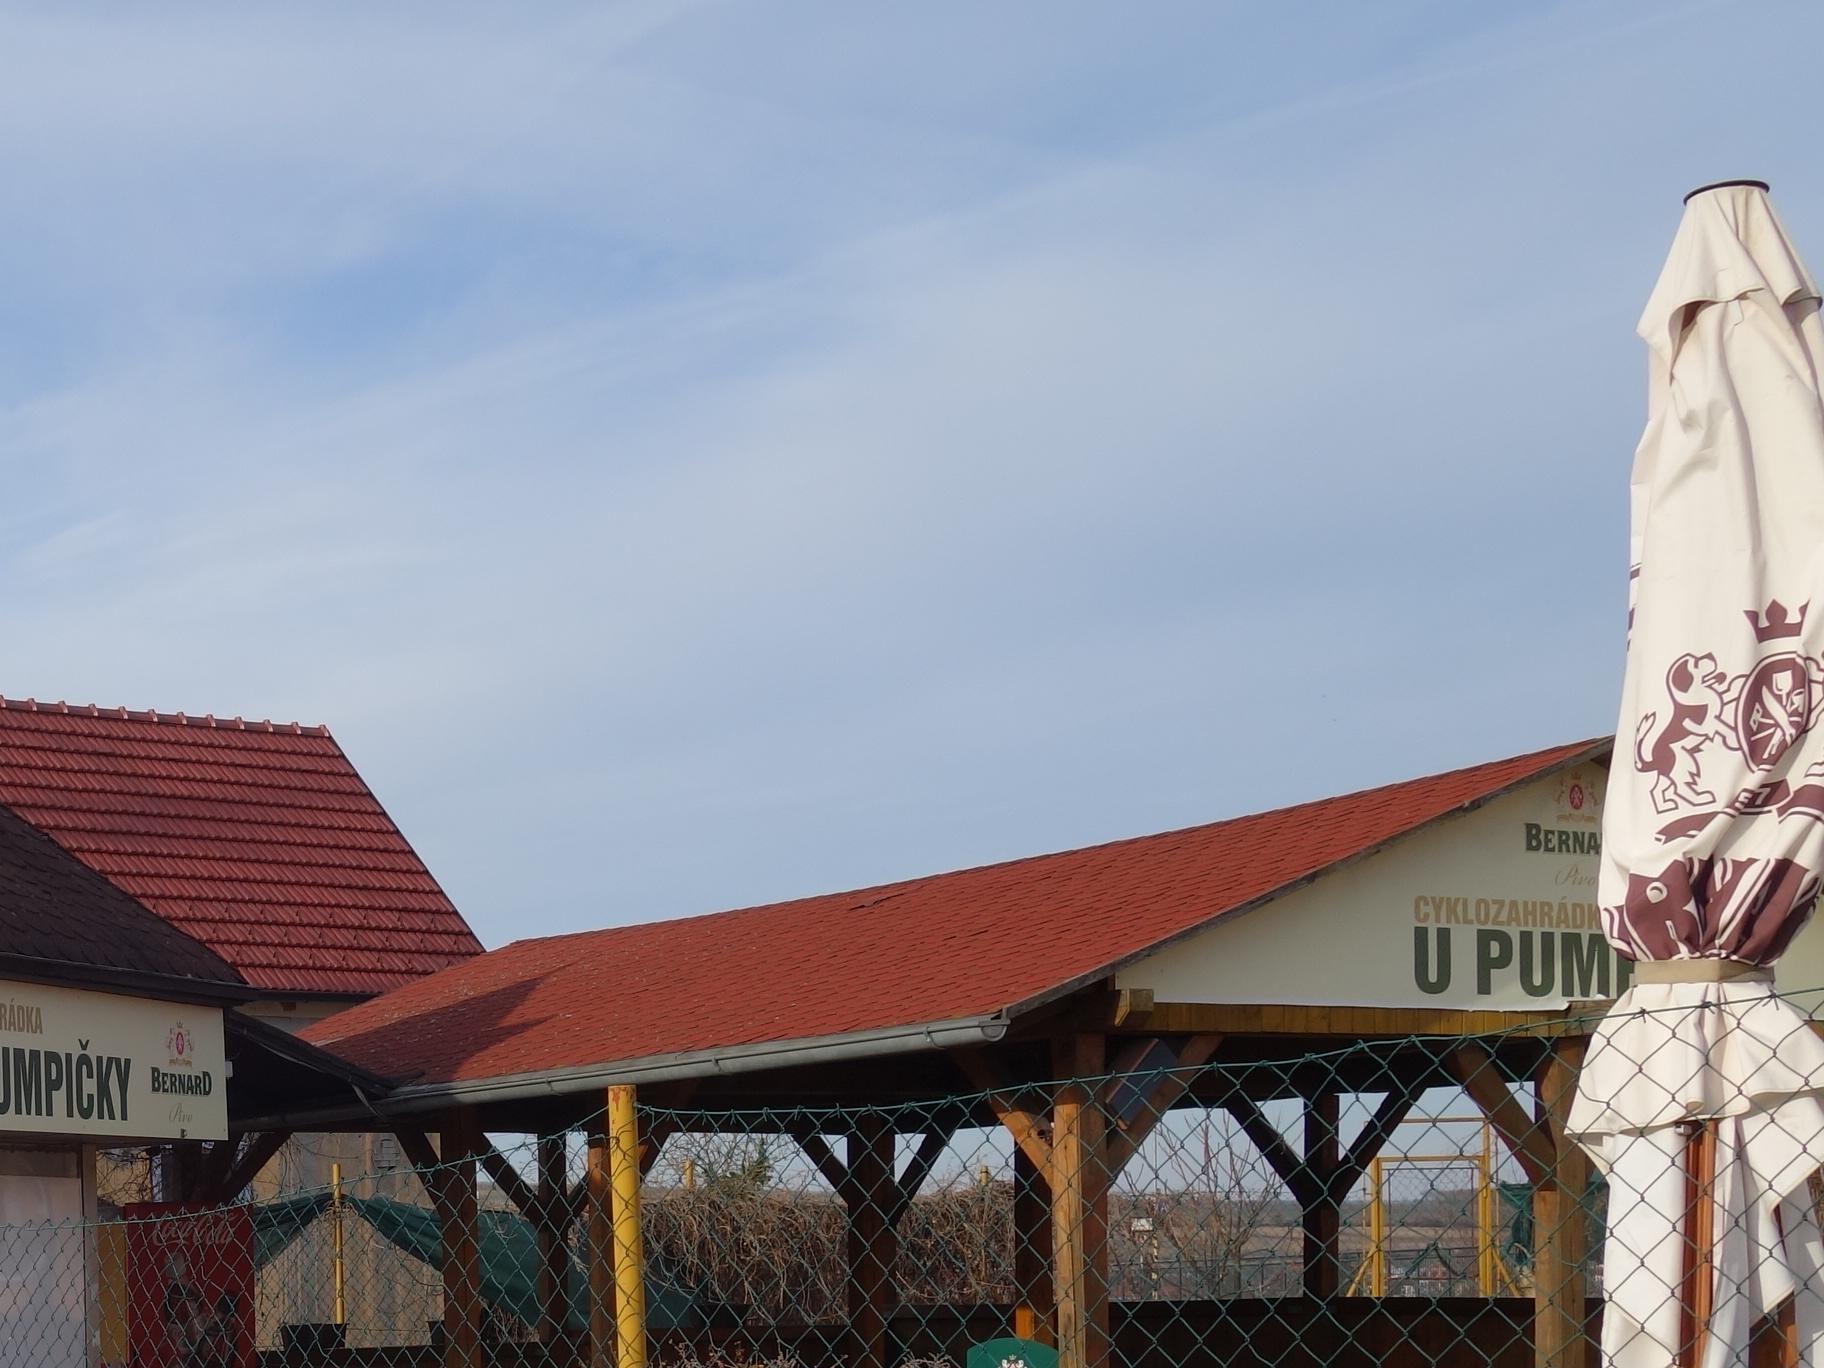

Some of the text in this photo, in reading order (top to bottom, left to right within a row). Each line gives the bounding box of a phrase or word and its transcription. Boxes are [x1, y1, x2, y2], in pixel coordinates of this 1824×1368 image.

[1524, 822, 1603, 855] BERNA
[1414, 896, 1600, 929] CYKLOZAHRÁDK
[1414, 926, 1635, 998] U PUM
[151, 1067, 212, 1096] BERNARD
